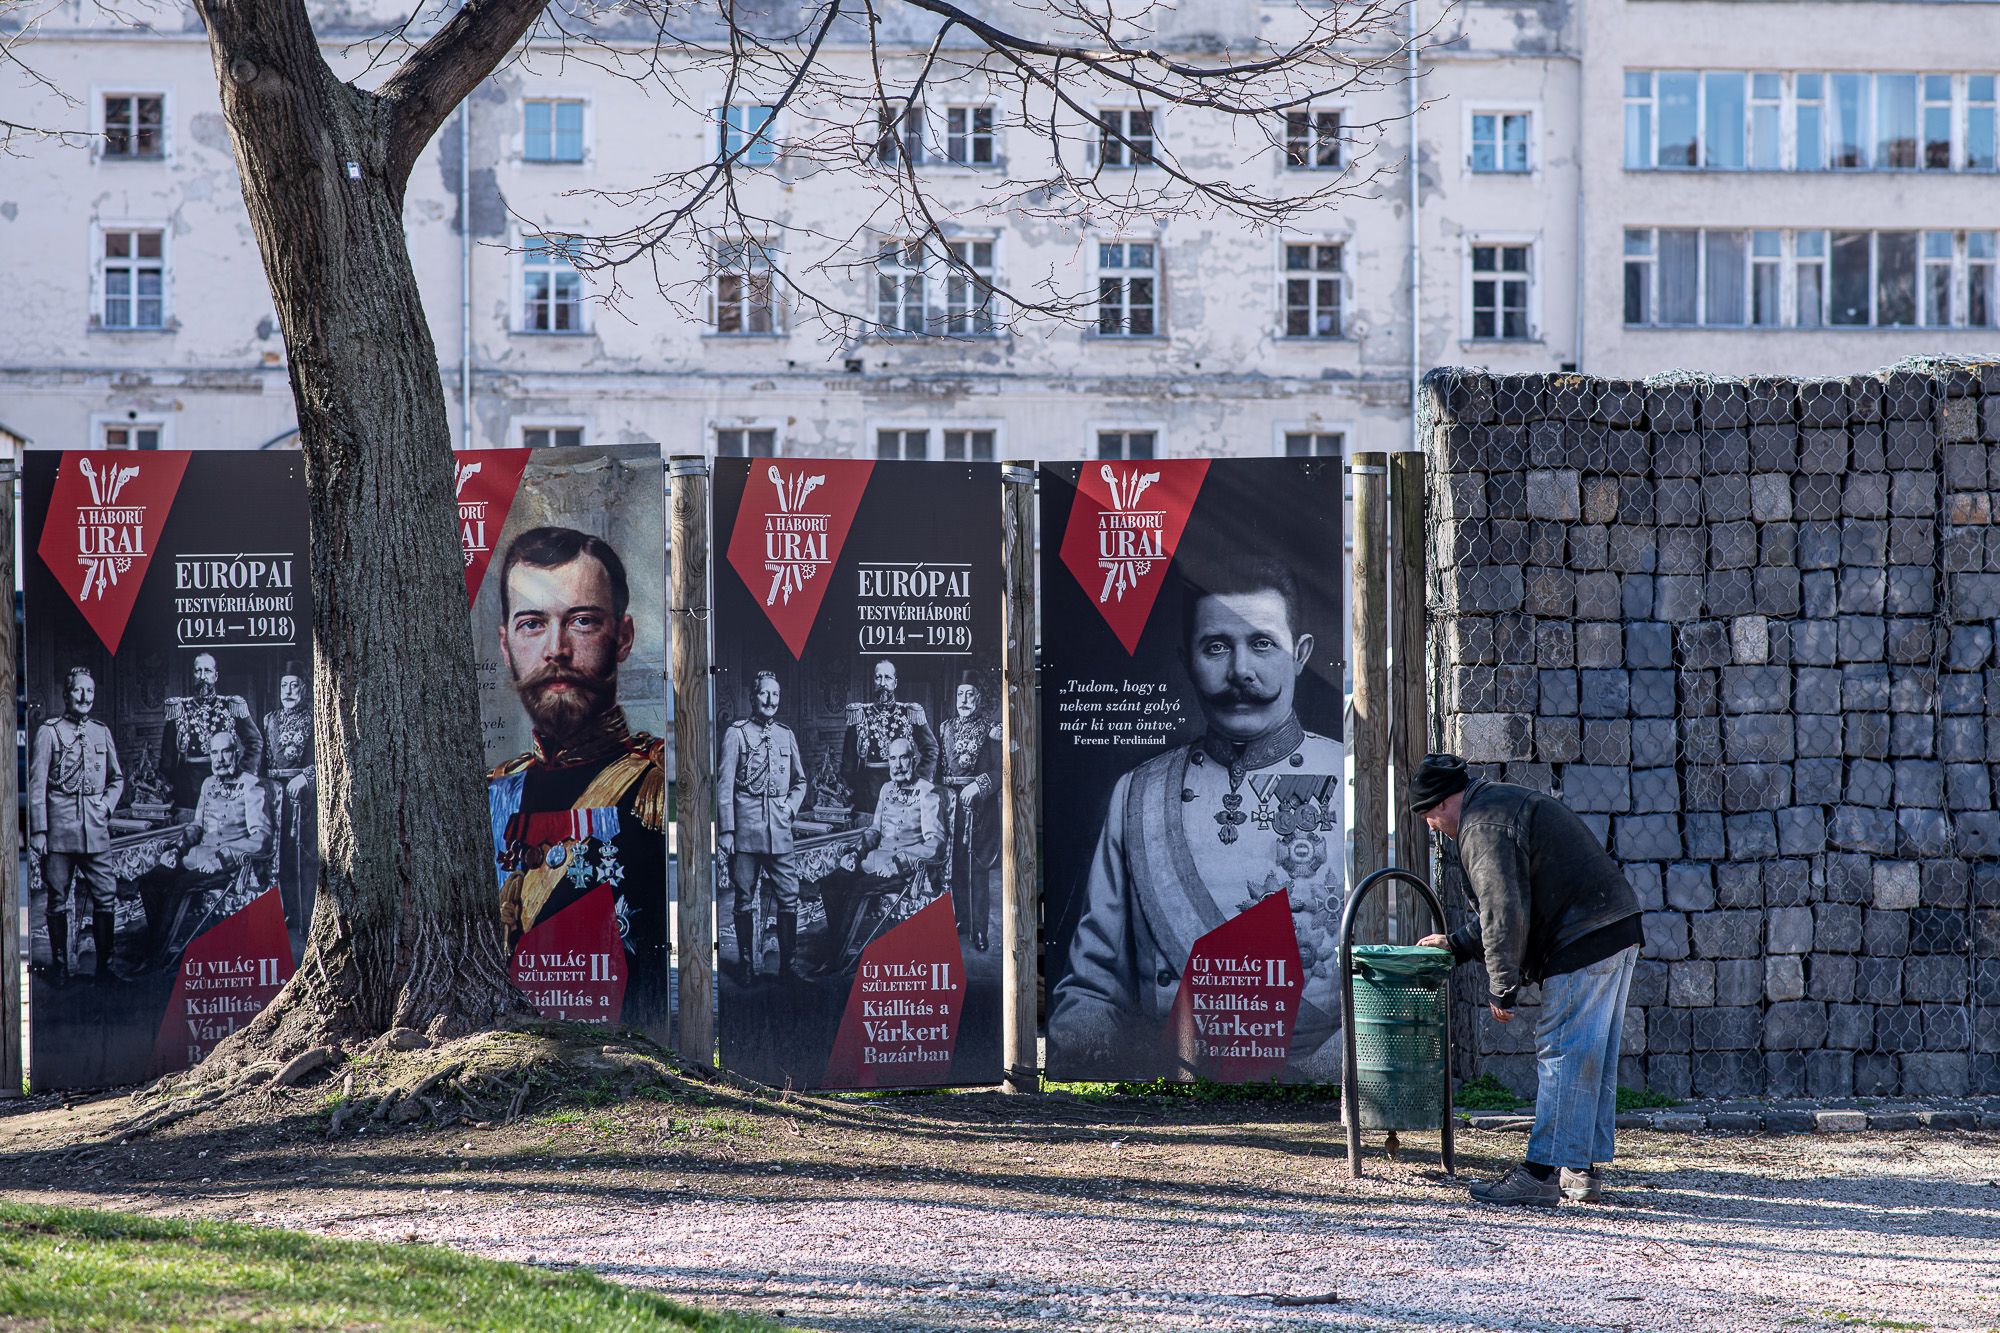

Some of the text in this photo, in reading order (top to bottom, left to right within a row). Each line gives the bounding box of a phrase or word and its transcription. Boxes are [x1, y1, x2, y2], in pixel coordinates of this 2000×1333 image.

[77, 506, 143, 525] A HÁBORÚ
[765, 514, 829, 532] A HÁBORÚ
[1098, 511, 1163, 529] A HÁBORÚ
[78, 525, 144, 554] URAI
[765, 532, 829, 560] URAI
[1098, 529, 1164, 558] URAI
[175, 552, 293, 589] EURÓPAI
[857, 562, 971, 598] EURÓPAI
[175, 592, 294, 613] TESTVÉRHÁBORÚ
[857, 602, 971, 621] TESTVÉRHÁBORÚ
[1123, 680, 1155, 695] hogy
[1158, 684, 1168, 693] a
[1059, 699, 1181, 715] nekem szánt golyó
[1059, 718, 1087, 731] már
[1090, 718, 1104, 731] ki
[1107, 721, 1133, 731] van
[1073, 735, 1166, 745] Ferenc Ferdinánd
[185, 956, 254, 976] ÚJ VILÁG
[518, 949, 586, 968] ÚJ VILÁG
[589, 953, 618, 982] II.
[1192, 954, 1262, 974] ÚJ VILÁG
[258, 958, 287, 986] II.
[518, 970, 586, 982] SZÜLETETT
[862, 960, 928, 979] ÚJ VILÁG
[930, 963, 957, 991] II.
[1265, 959, 1294, 988] II.
[185, 976, 254, 990] SZÜLETETT
[862, 980, 927, 992] SZÜLETETT
[1192, 973, 1262, 987] SZÜLETETT
[186, 995, 262, 1015] Kiállítás
[599, 995, 610, 1007] a
[863, 999, 950, 1017] Kiállítás a
[1192, 993, 1286, 1012] Kiállítás a
[863, 1020, 950, 1043] Várkert
[1192, 1014, 1286, 1037] Várkert
[863, 1045, 950, 1064] Bazárban
